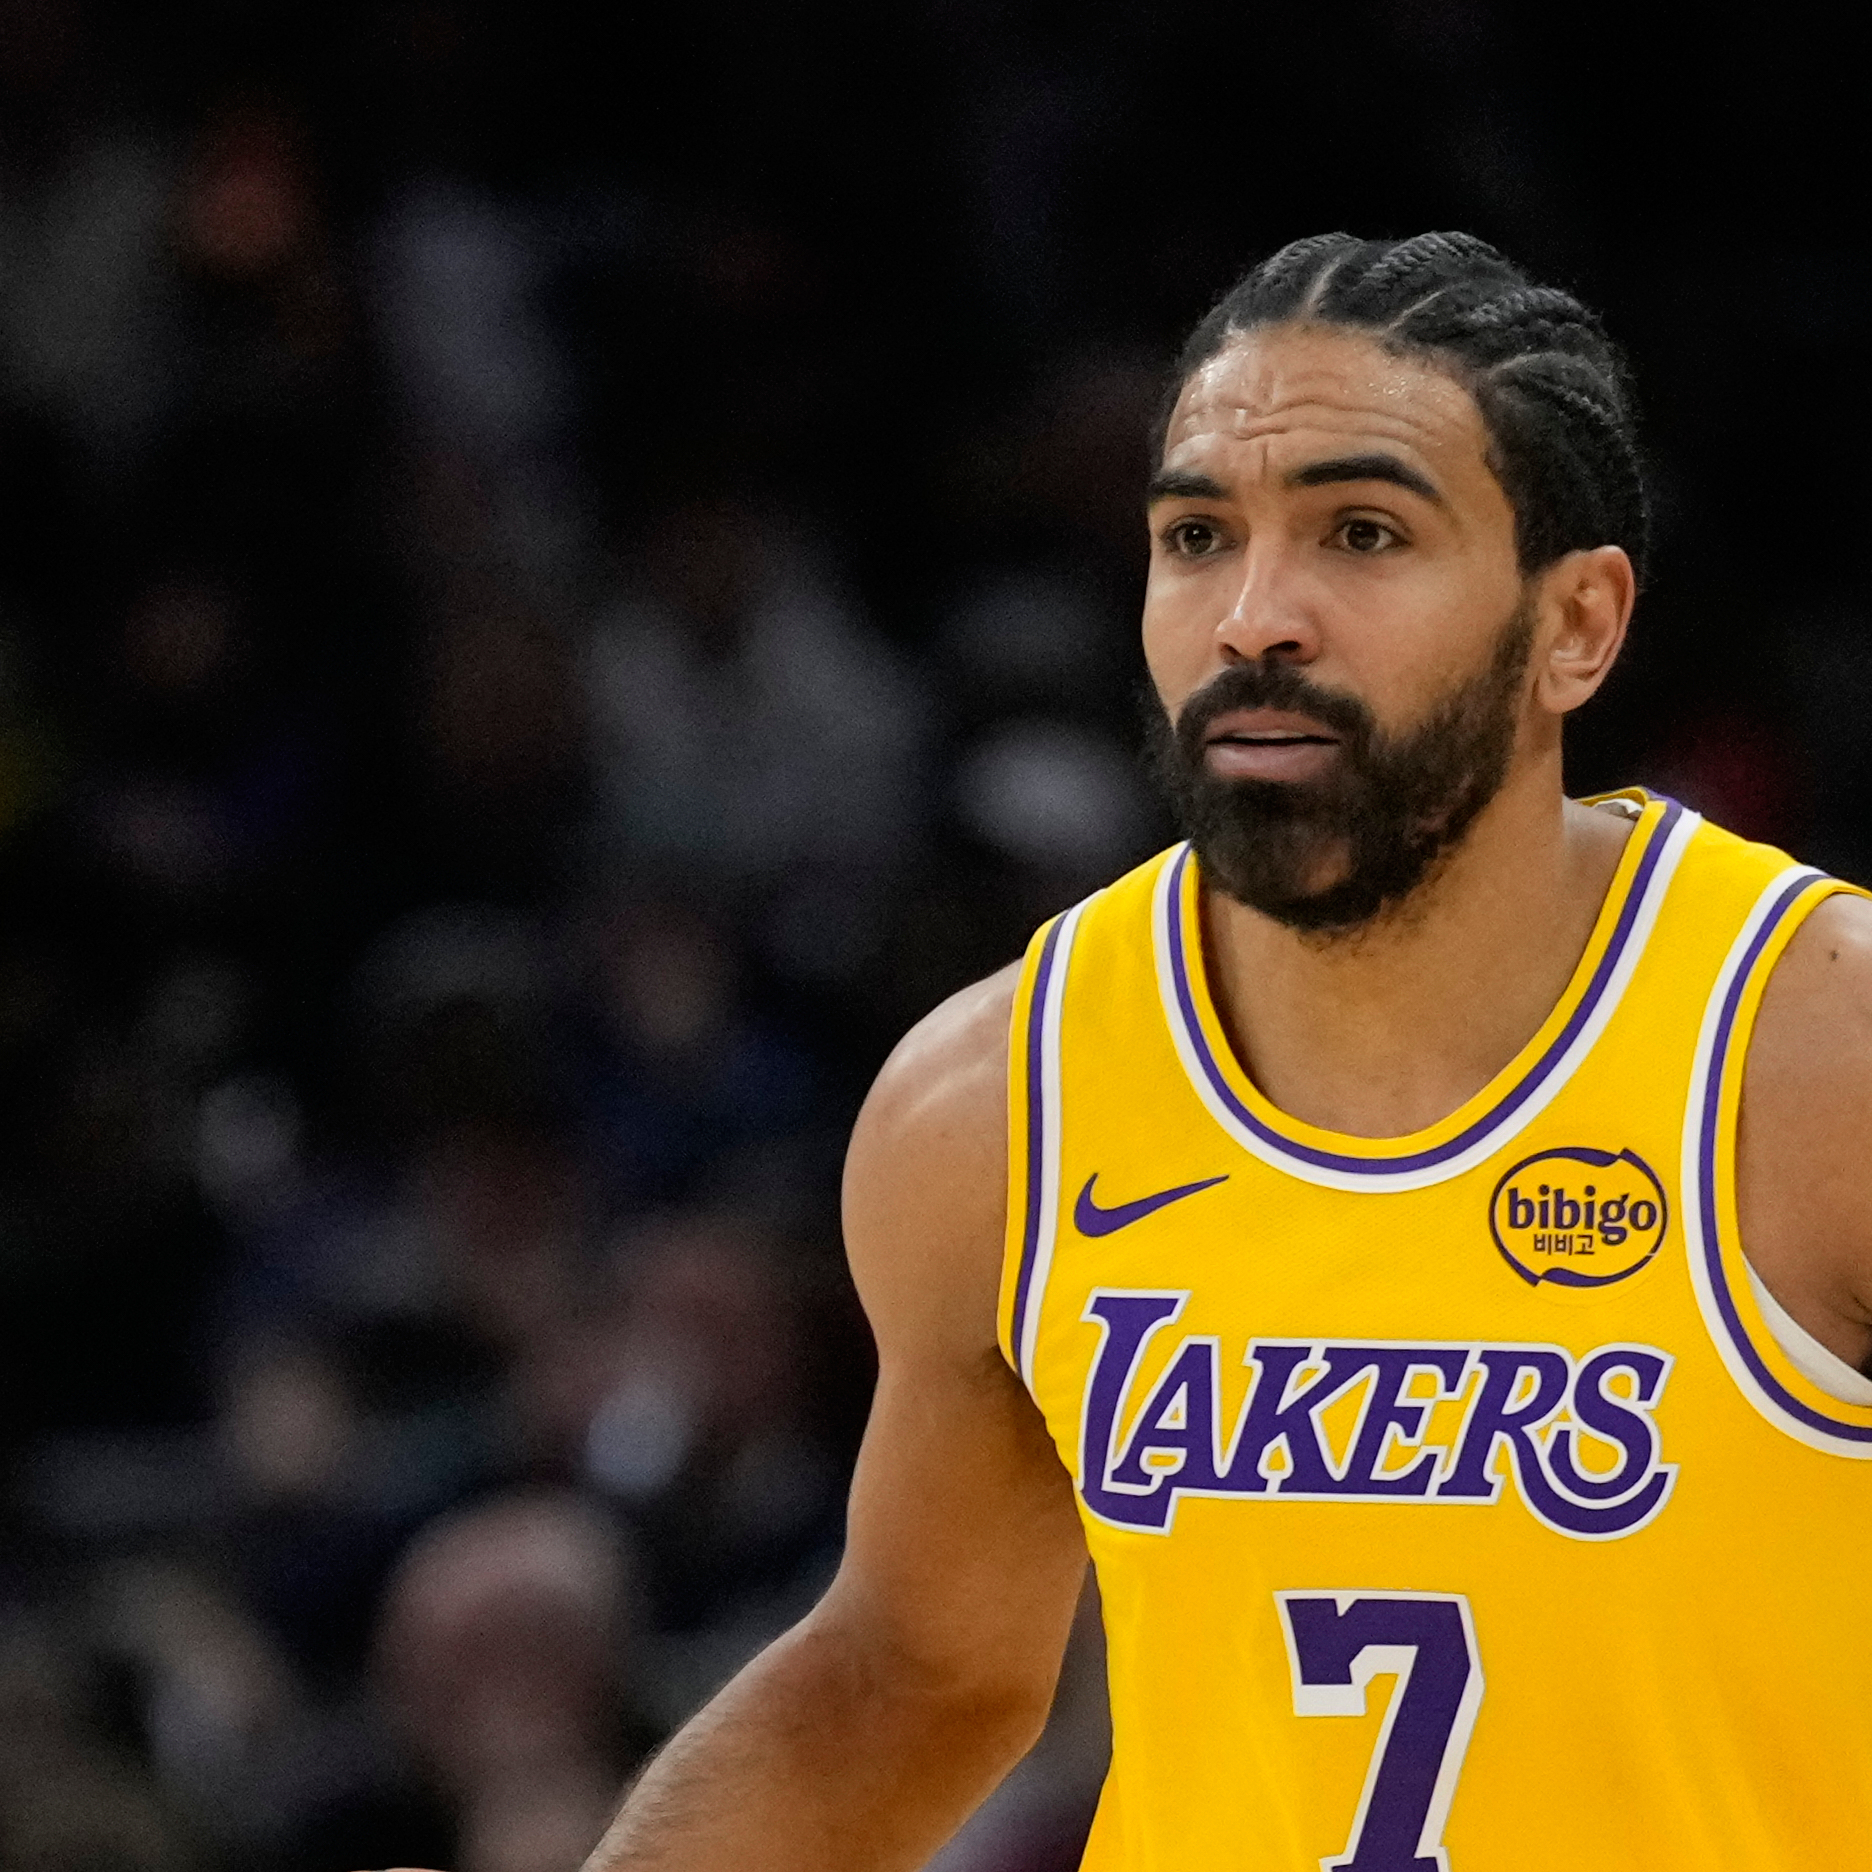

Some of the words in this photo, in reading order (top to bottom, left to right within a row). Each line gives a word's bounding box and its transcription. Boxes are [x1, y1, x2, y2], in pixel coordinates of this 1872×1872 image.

[1507, 1184, 1657, 1246] bibigo
[1533, 1234, 1595, 1256] 비비고
[1076, 1287, 1679, 1542] LAKERS
